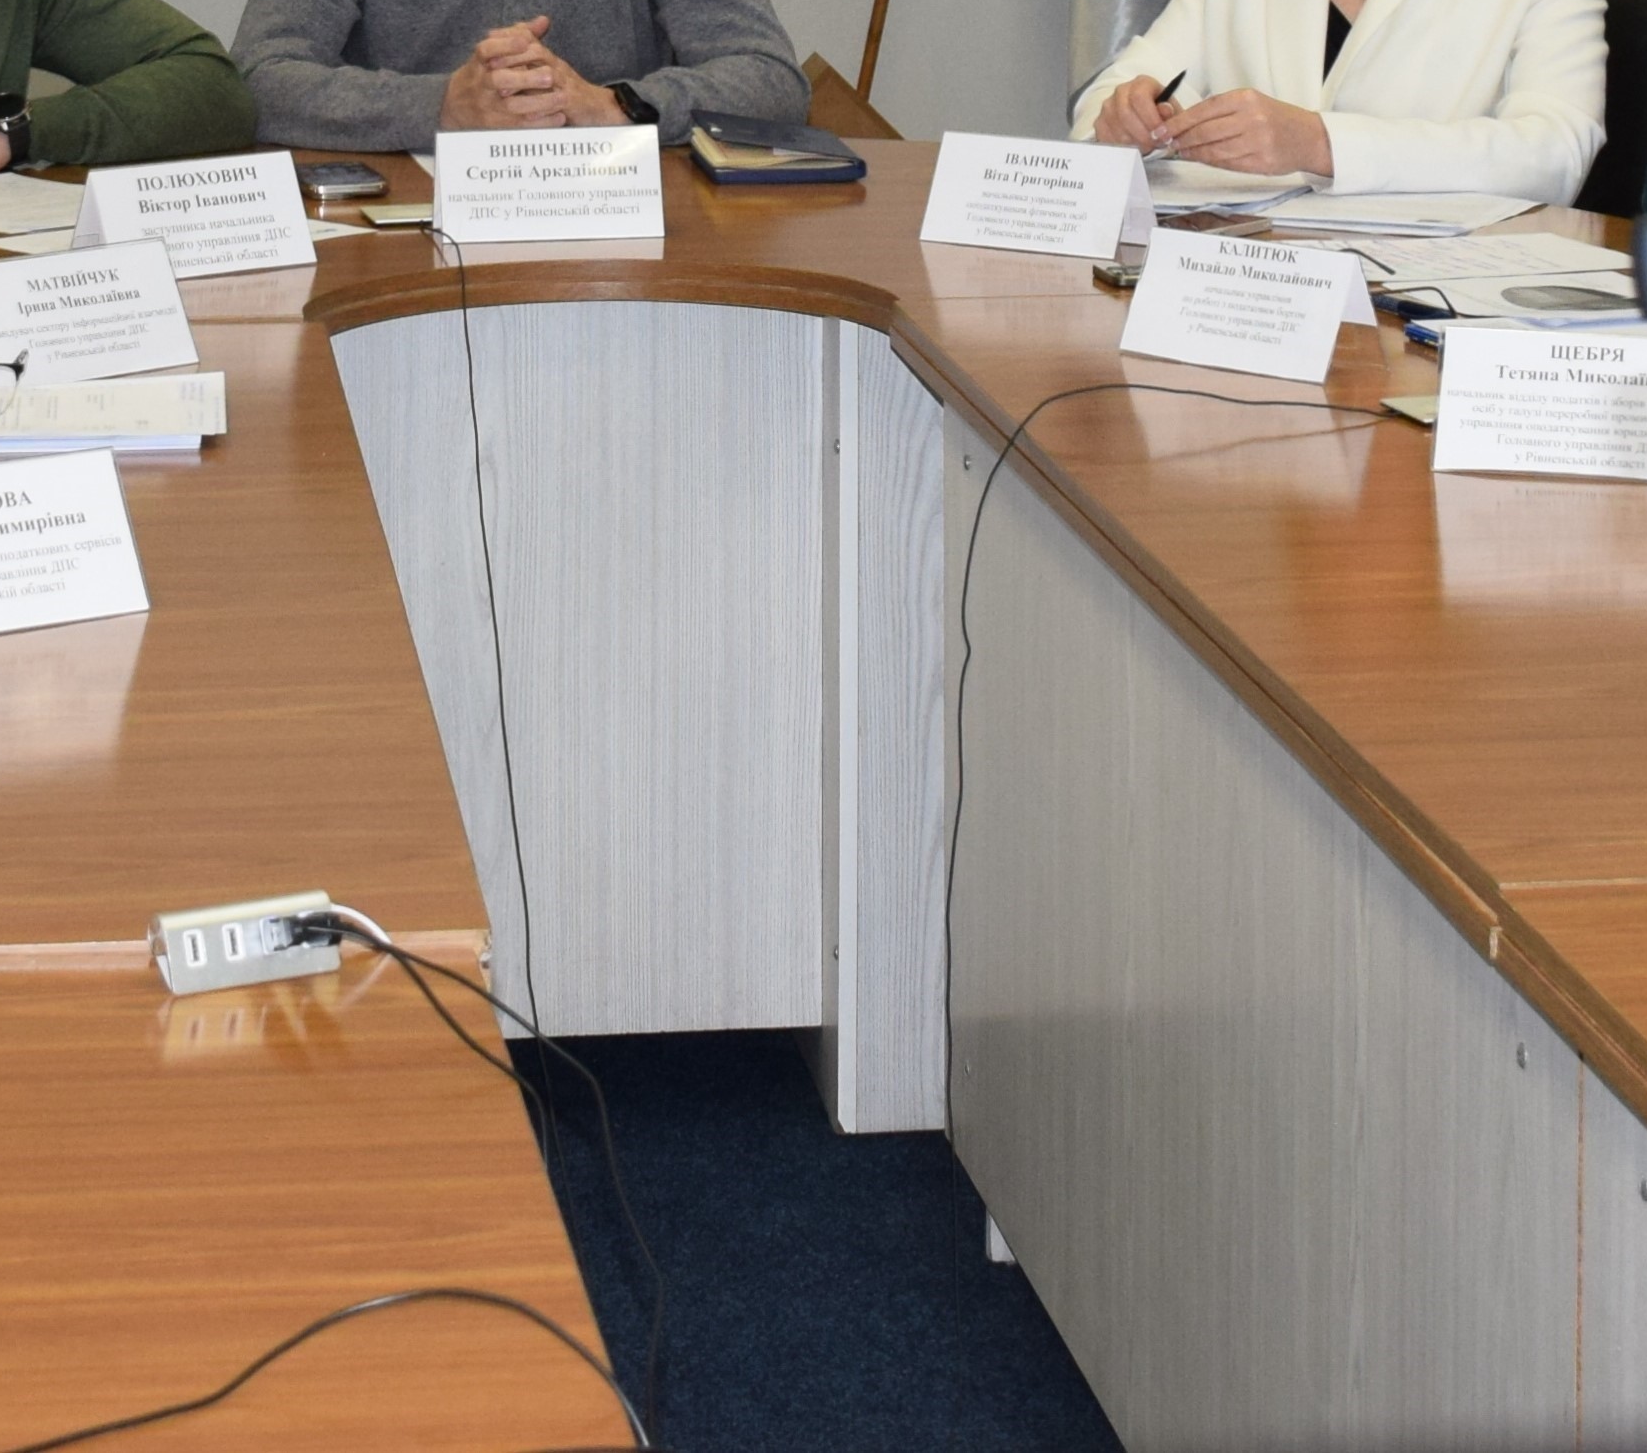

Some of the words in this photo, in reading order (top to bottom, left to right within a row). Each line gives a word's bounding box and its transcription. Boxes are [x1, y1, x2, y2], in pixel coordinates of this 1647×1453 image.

[489, 141, 613, 159] ВІННІЧЕНКО
[1004, 152, 1072, 170] ІВАНЧИК
[136, 166, 258, 192] ПОЛЮХОВИЧ
[466, 164, 523, 182] Сергій
[528, 163, 639, 181] Аркадійович
[983, 168, 1009, 182] Віта
[1013, 171, 1085, 190] Григорівна
[138, 197, 191, 215] Віктор
[196, 190, 267, 209] Іванович
[173, 251, 234, 268] івненській
[1219, 241, 1300, 264] КАЛИТЮК
[27, 267, 120, 293] МАТВІЙЧУК
[1177, 256, 1236, 277] Михайло
[1239, 265, 1332, 290] Миколайович
[17, 302, 57, 317] Ірина
[59, 289, 141, 310] Миколаївна
[1550, 345, 1626, 363] ЩЕБРЯ
[1495, 364, 1560, 382] Тетяна
